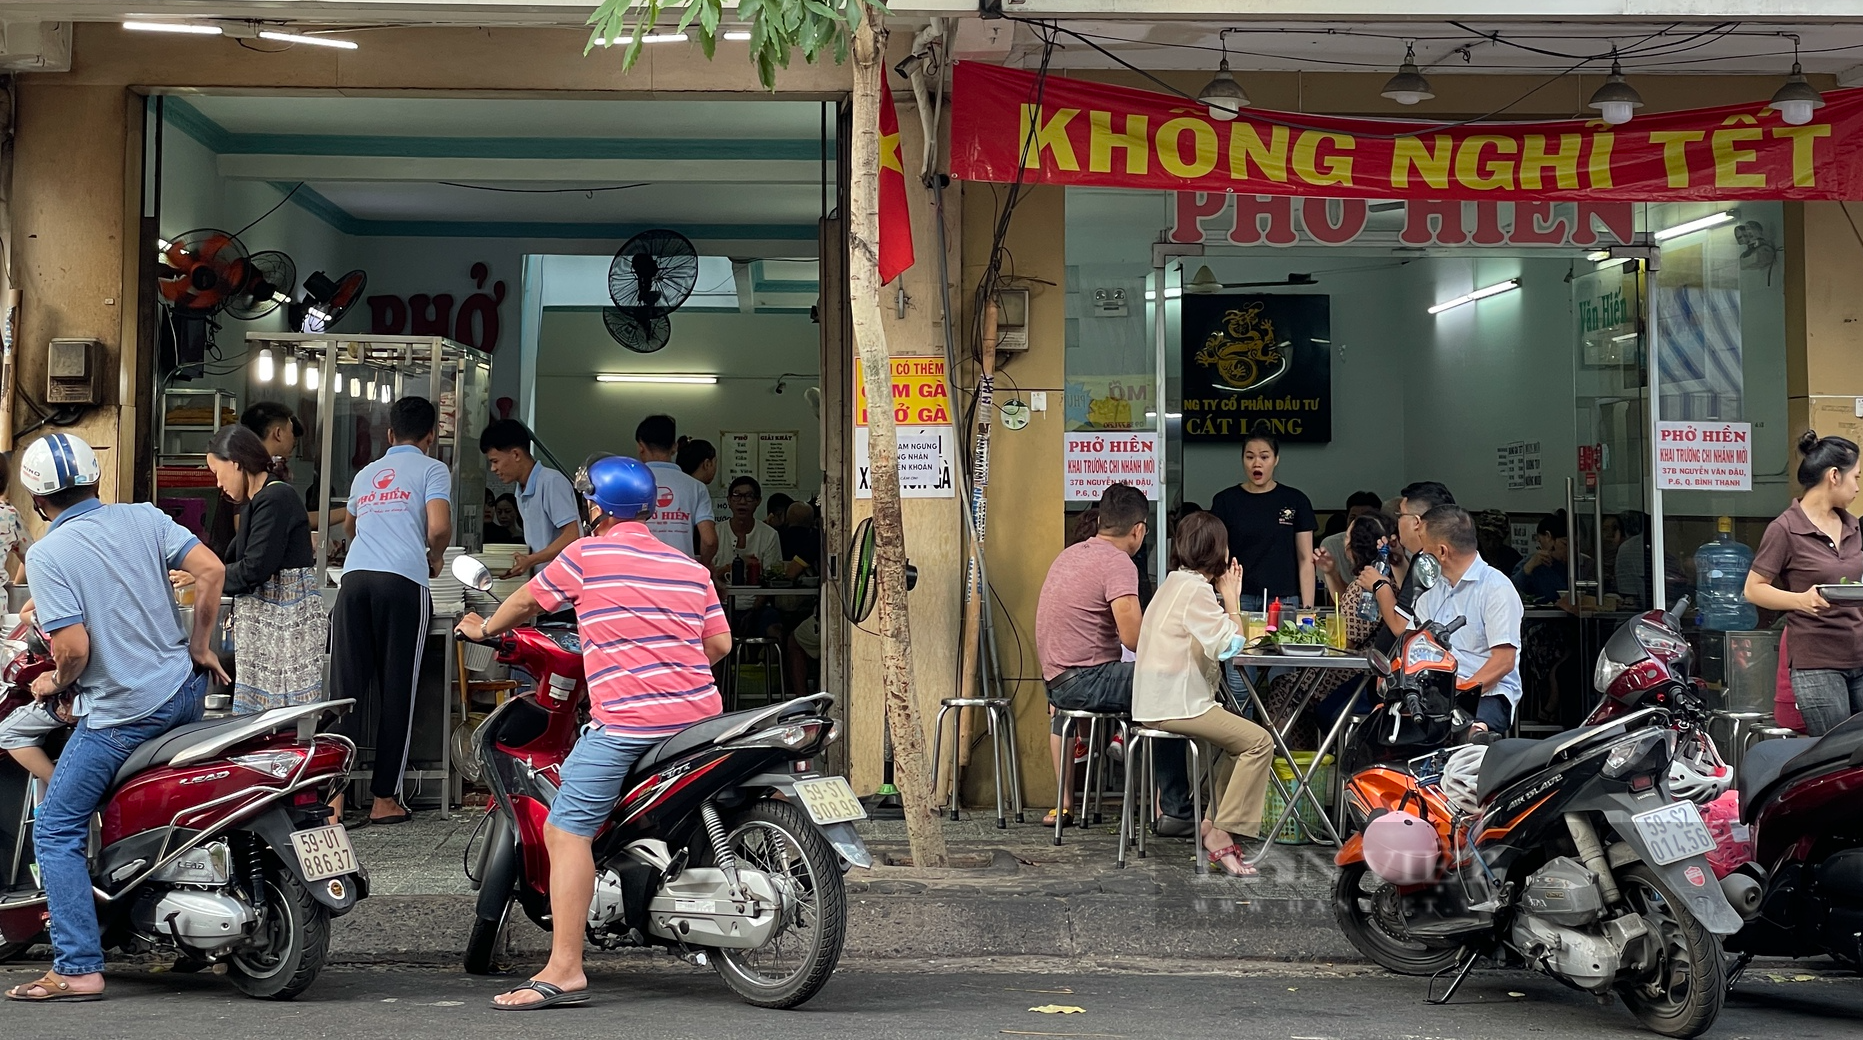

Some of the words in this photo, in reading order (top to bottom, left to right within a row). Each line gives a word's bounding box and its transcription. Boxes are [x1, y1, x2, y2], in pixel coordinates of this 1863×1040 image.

[1019, 103, 1356, 187] KHÔNG
[1390, 118, 1616, 191] NGHỈ
[1649, 106, 1832, 188] TẾT
[367, 262, 505, 354] PHỞ
[1579, 299, 1599, 333] Văn
[1601, 286, 1627, 328] Hiến
[896, 360, 910, 374] CÓ
[914, 360, 944, 374] THÊM
[918, 380, 947, 398] GÀ
[1203, 400, 1219, 411] TY
[1221, 394, 1237, 411] CỔ
[1241, 395, 1273, 411] PHẦN
[1276, 395, 1300, 411] ĐẦU
[1303, 398, 1319, 411] TƯ
[917, 404, 948, 422] GÀ
[1186, 414, 1233, 435] CÁT
[1661, 425, 1698, 442] PHỞ
[1702, 425, 1747, 443] HIỀN
[1069, 436, 1104, 453] PHỞ
[1109, 435, 1153, 453] HIỀN
[1660, 448, 1675, 462] KHAI
[1702, 449, 1712, 463] CHI
[1713, 446, 1735, 464] NHÁNH
[1736, 446, 1749, 464] MỚI
[1068, 460, 1082, 474] KHAI
[1109, 460, 1120, 474] CHI
[1121, 456, 1142, 474] NHÁNH
[1143, 456, 1155, 474] MỚI
[1679, 466, 1709, 475] NGUYỄN
[1711, 467, 1726, 475] VĂN
[1087, 475, 1116, 486] NGUYỄN
[1668, 479, 1683, 487] P.6,
[1695, 478, 1713, 487] BÌNH
[1715, 479, 1741, 488] THẠNH
[179, 770, 230, 785] LEAD
[804, 780, 844, 801] 59-S1
[1506, 795, 1525, 811] AIR
[1525, 773, 1564, 800] BLADE
[1636, 792, 1656, 800] HONDA
[811, 798, 861, 821] 908.96
[1643, 807, 1694, 837] 59-S2
[300, 829, 341, 854] 59-U1
[1650, 828, 1710, 861] 014.56
[177, 860, 205, 870] LEAD
[303, 849, 351, 878] 886.37
